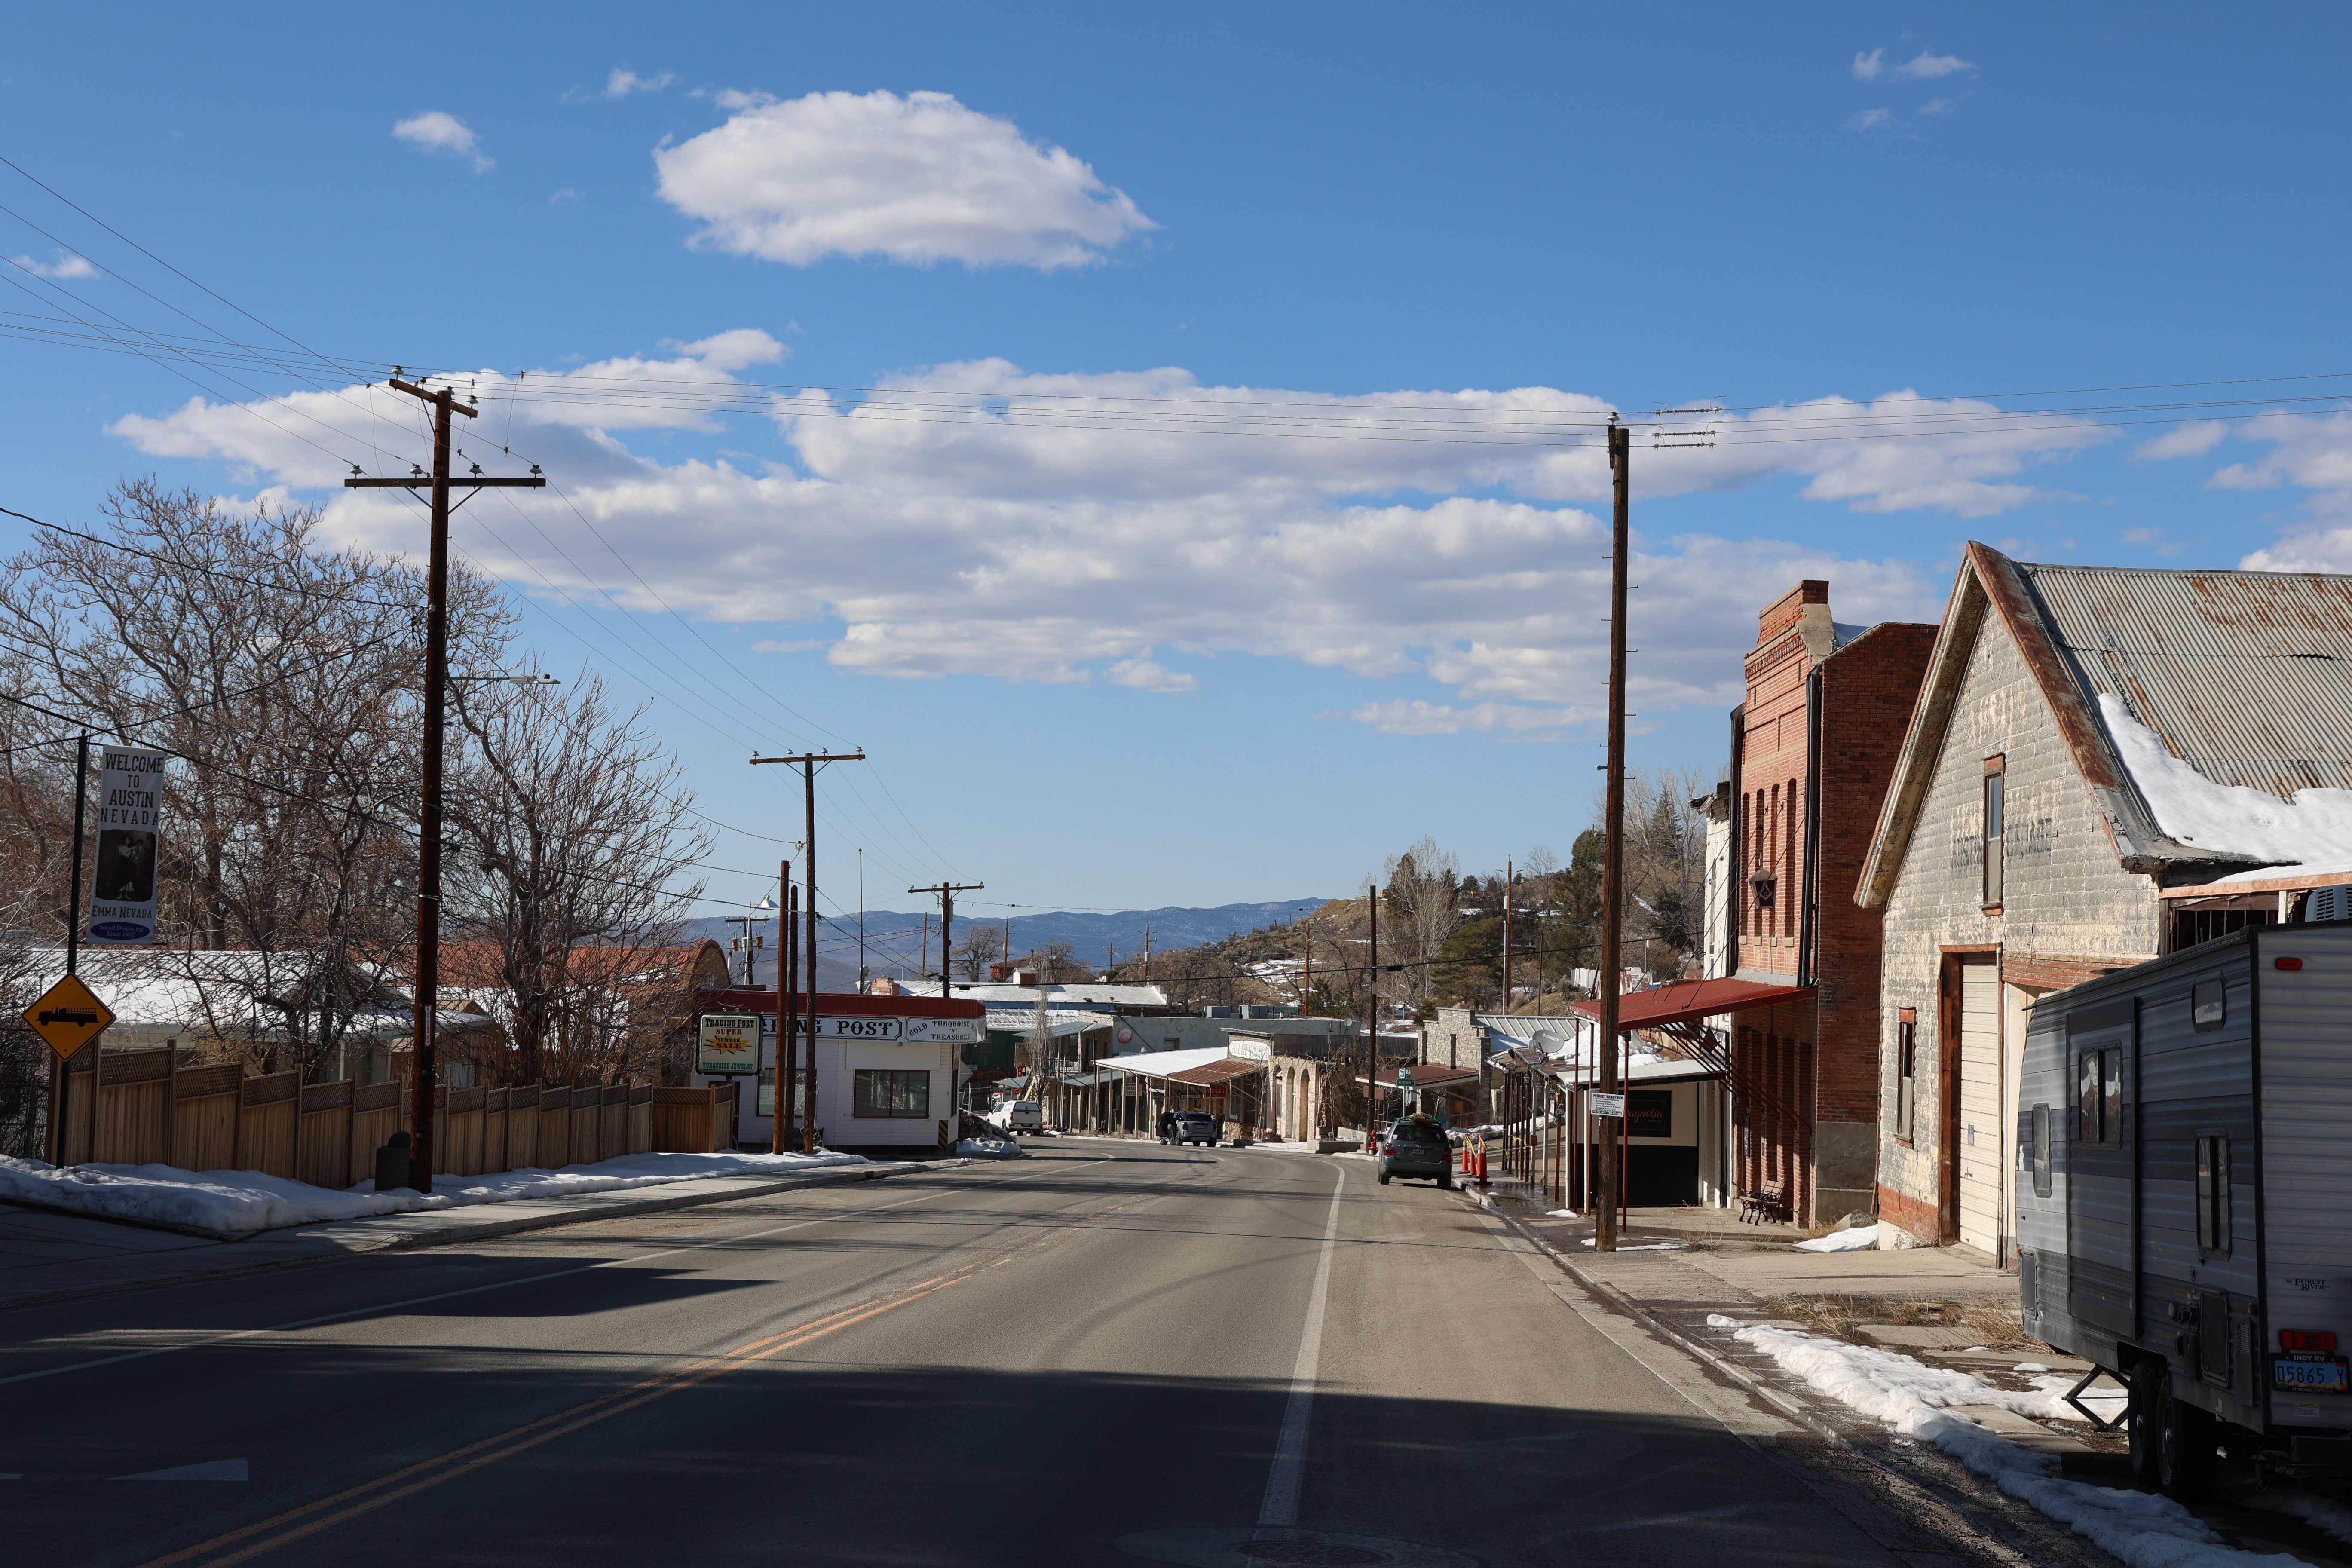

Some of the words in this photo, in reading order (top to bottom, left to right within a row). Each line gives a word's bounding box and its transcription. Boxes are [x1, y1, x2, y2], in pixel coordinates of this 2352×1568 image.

[105, 753, 164, 773] WELCOME
[128, 774, 140, 788] TO
[109, 789, 154, 808] AUSTIN
[100, 808, 158, 825] NEVADA
[705, 1018, 735, 1027] TRADING
[738, 1019, 754, 1027] POST
[836, 1020, 893, 1036] POST
[909, 1023, 928, 1036] GOLD
[1627, 1109, 1664, 1123] agnolia
